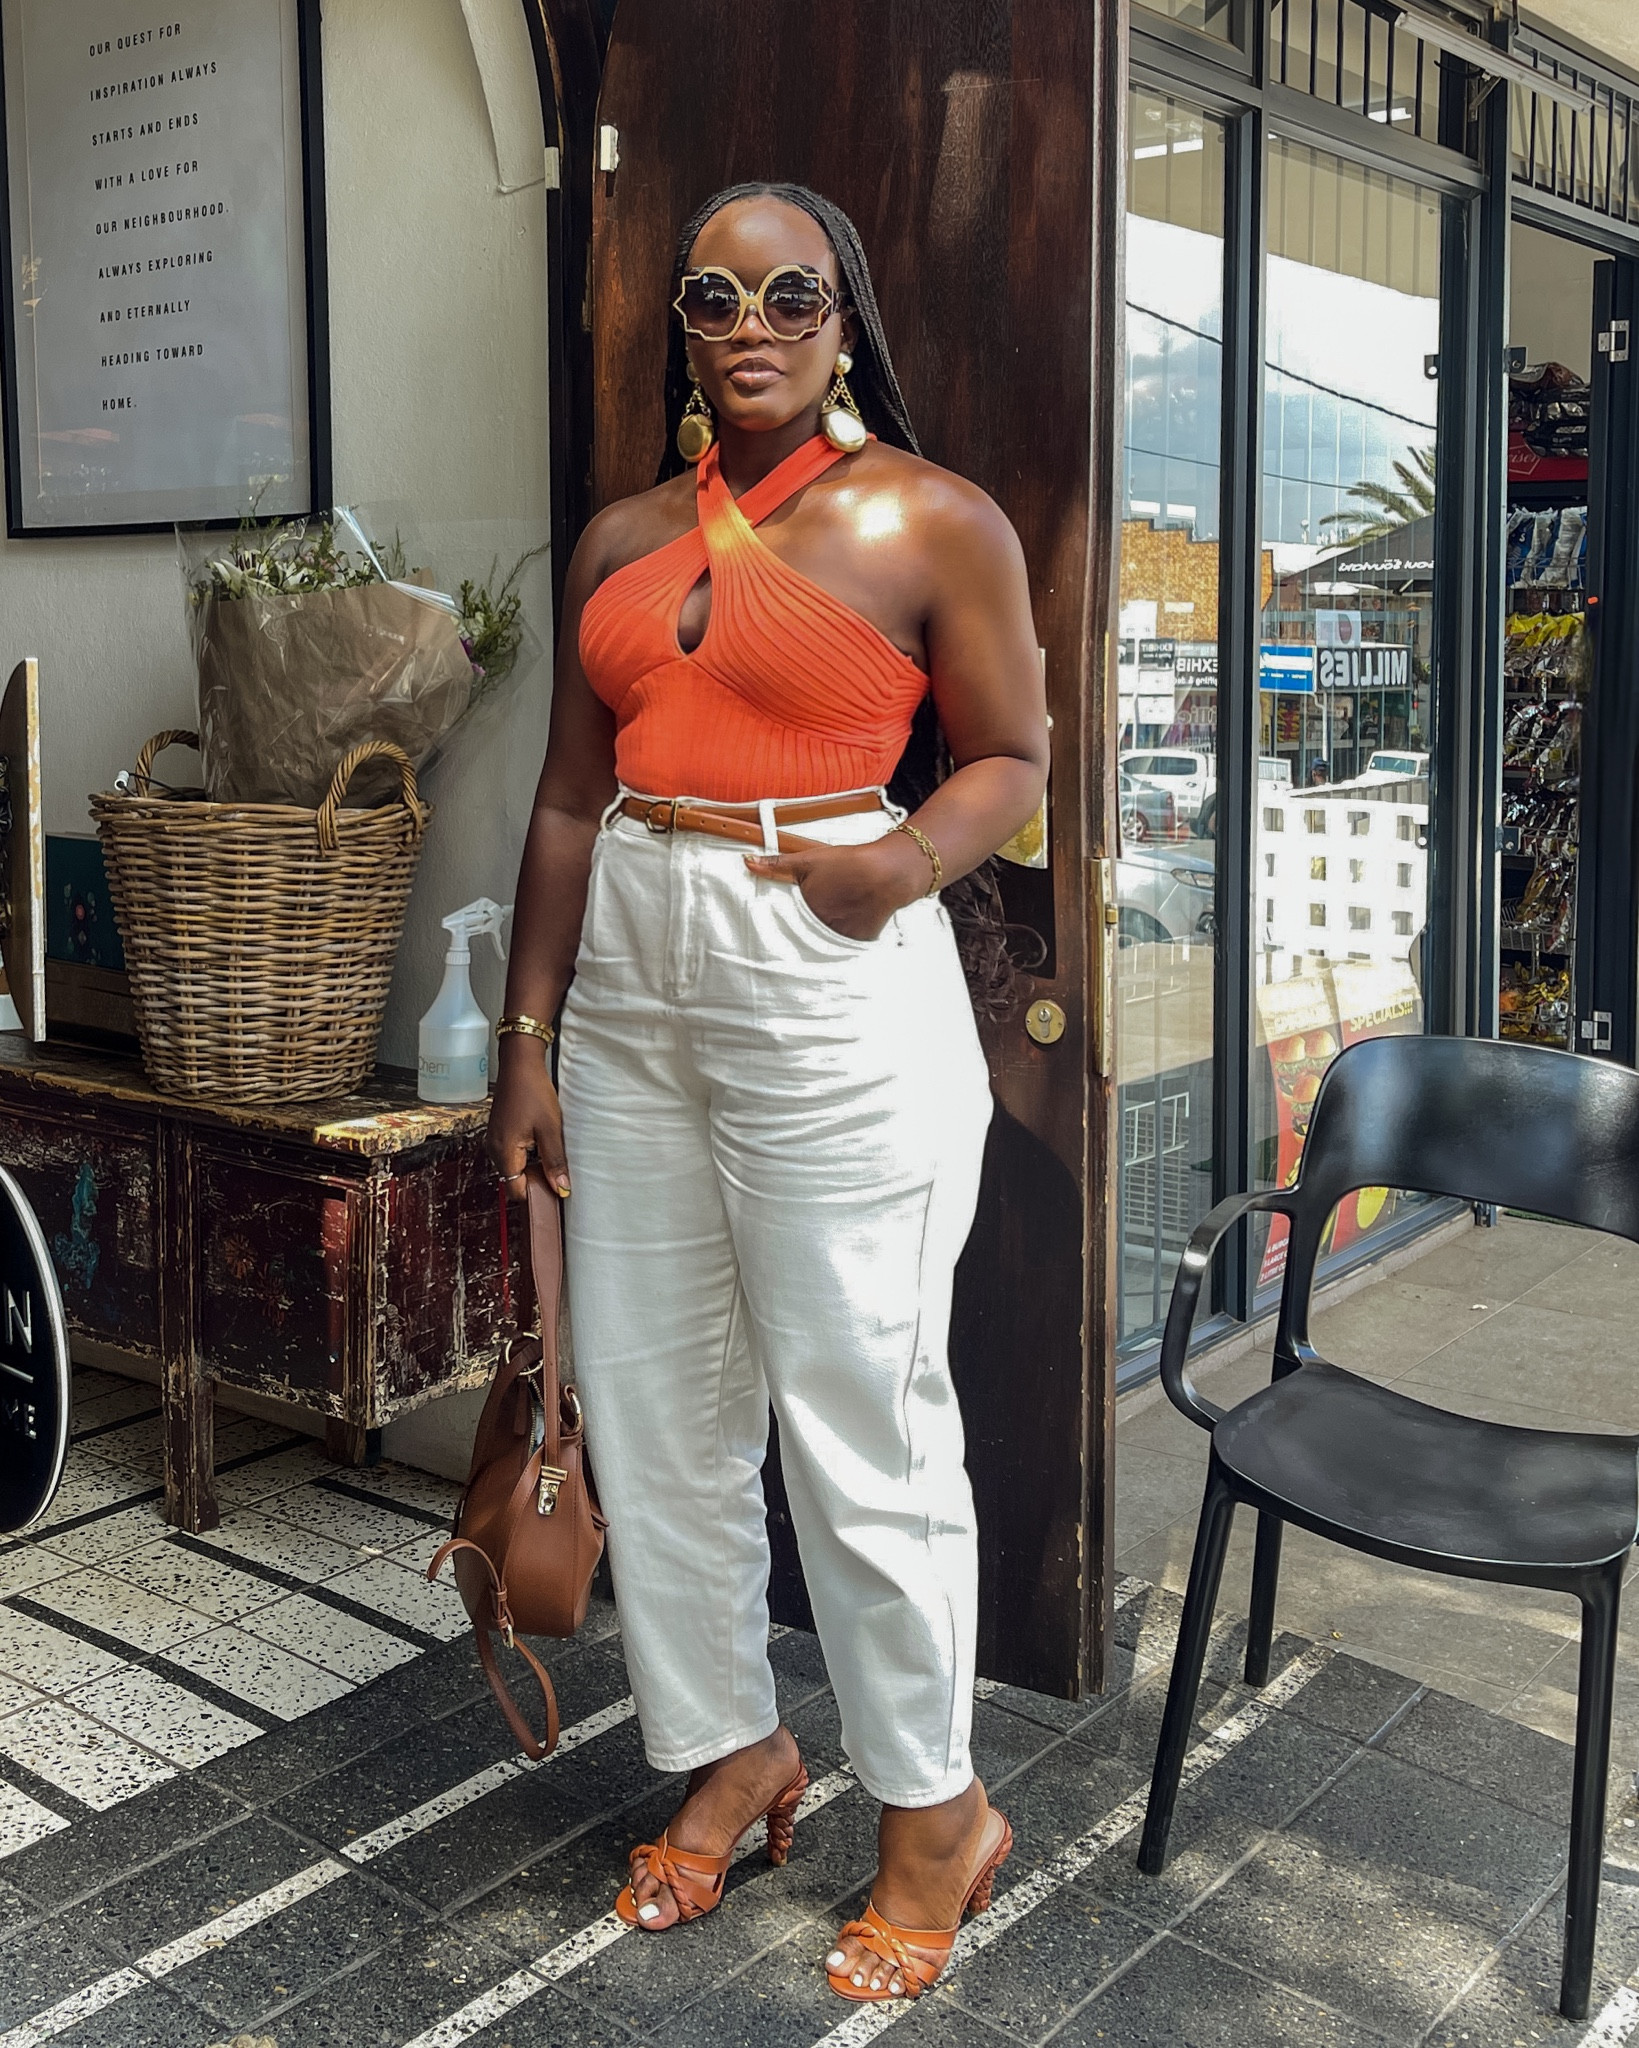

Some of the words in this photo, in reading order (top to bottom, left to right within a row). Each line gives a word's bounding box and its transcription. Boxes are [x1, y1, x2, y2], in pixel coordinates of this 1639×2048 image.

[89, 42, 111, 57] OUR
[117, 30, 153, 50] QUEST
[159, 24, 181, 40] FOR
[90, 74, 164, 102] INSPIRATION
[170, 62, 217, 84] ALWAYS
[91, 127, 133, 147] STARTS
[139, 121, 162, 137] AND
[168, 113, 198, 131] ENDS
[94, 175, 123, 191] WITH
[128, 173, 135, 185] A
[141, 166, 170, 182] LOVE
[176, 161, 199, 176] FOR
[95, 221, 118, 236] OUR
[123, 202, 228, 231] NEIGHBOURHOOD.
[98, 262, 142, 280] ALWAYS
[147, 251, 213, 272] EXPLORING
[99, 310, 121, 324] AND
[127, 300, 190, 320] ETERNALLY
[101, 351, 150, 368] HEADING
[155, 344, 203, 361] TOWARD
[102, 397, 136, 412] HOME.
